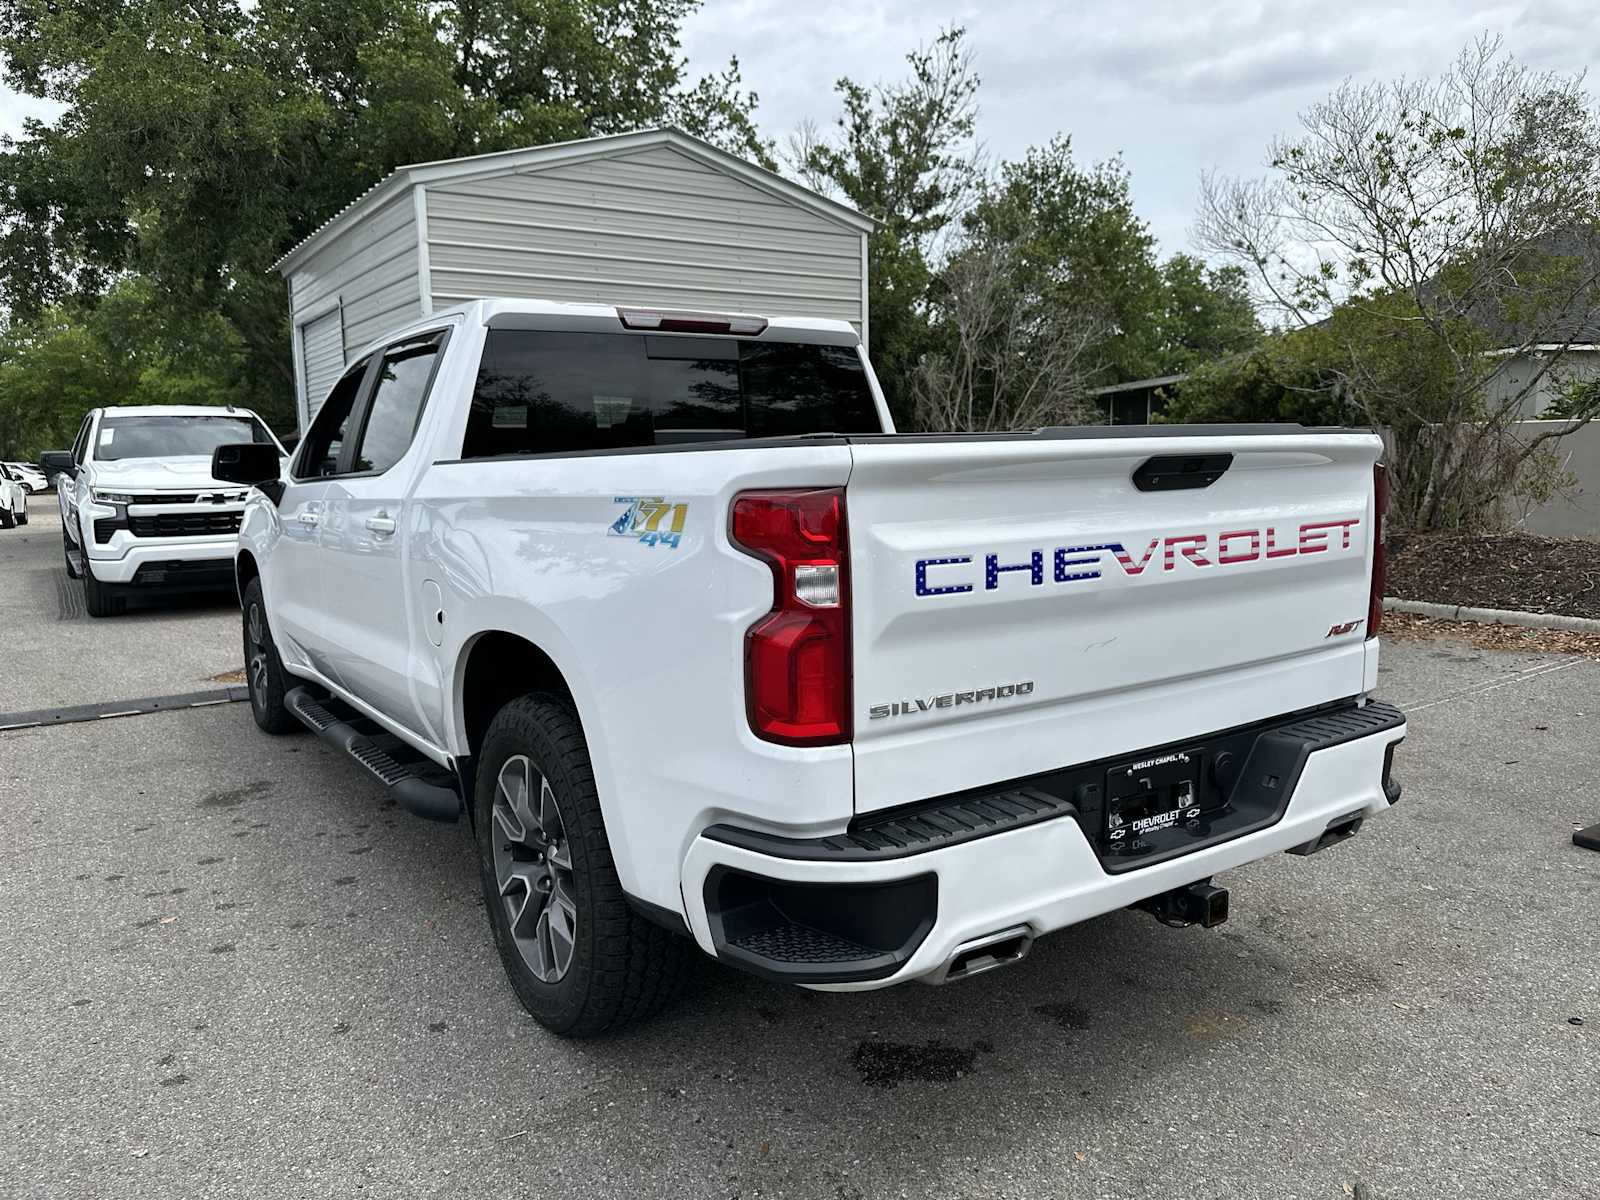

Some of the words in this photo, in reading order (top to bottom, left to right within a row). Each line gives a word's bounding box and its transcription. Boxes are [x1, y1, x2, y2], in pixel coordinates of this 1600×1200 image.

[607, 496, 689, 537] Z71
[915, 519, 1360, 596] CHEVROLET
[869, 681, 1034, 720] SILVERADO
[1132, 809, 1181, 831] CHEVROLET
